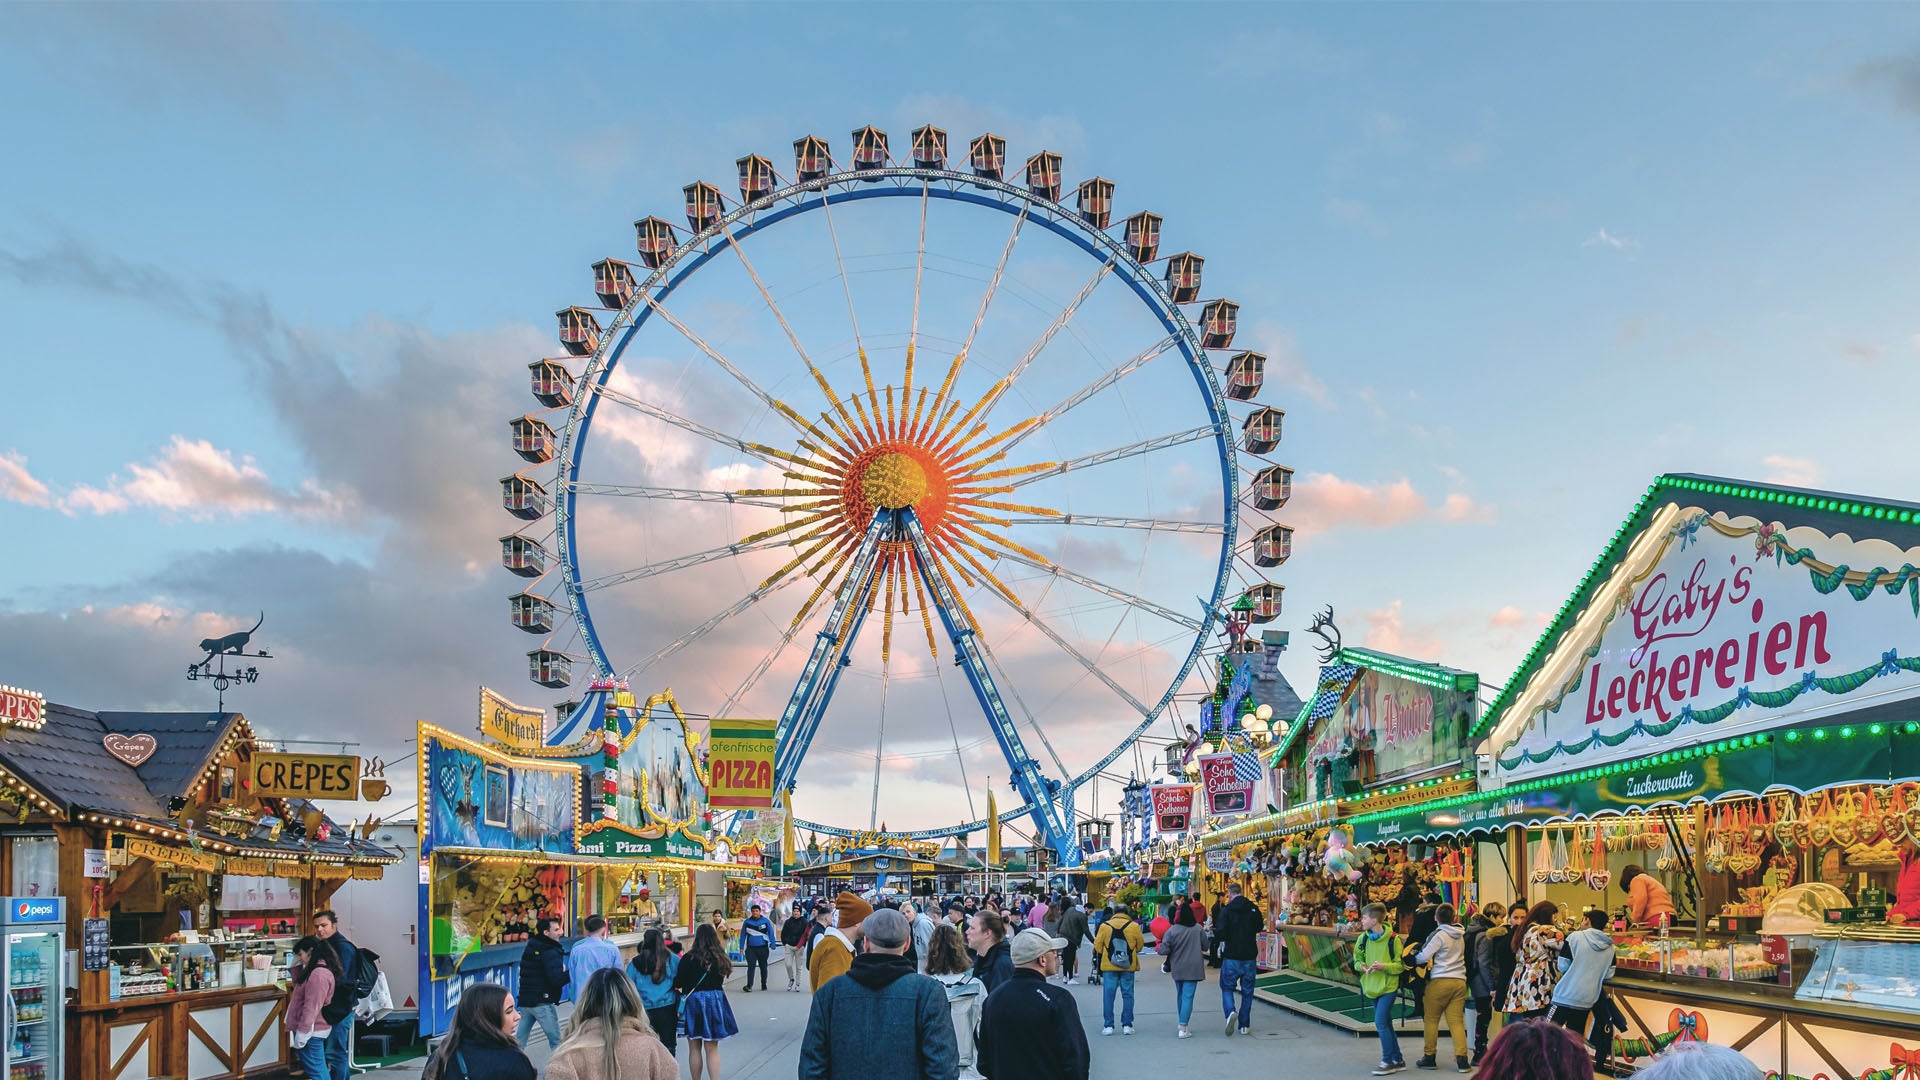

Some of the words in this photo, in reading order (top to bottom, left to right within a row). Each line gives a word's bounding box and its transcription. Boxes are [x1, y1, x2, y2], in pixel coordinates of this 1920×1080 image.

[1629, 554, 1752, 669] Gaby's
[1585, 598, 1832, 725] Leckereien
[711, 741, 774, 752] ofenfrische
[257, 759, 353, 792] CRÊPES
[712, 759, 772, 789] PIZZA
[1626, 769, 1694, 797] Zuckerwatte
[616, 841, 652, 853] Pizza
[31, 904, 53, 915] pepsi
